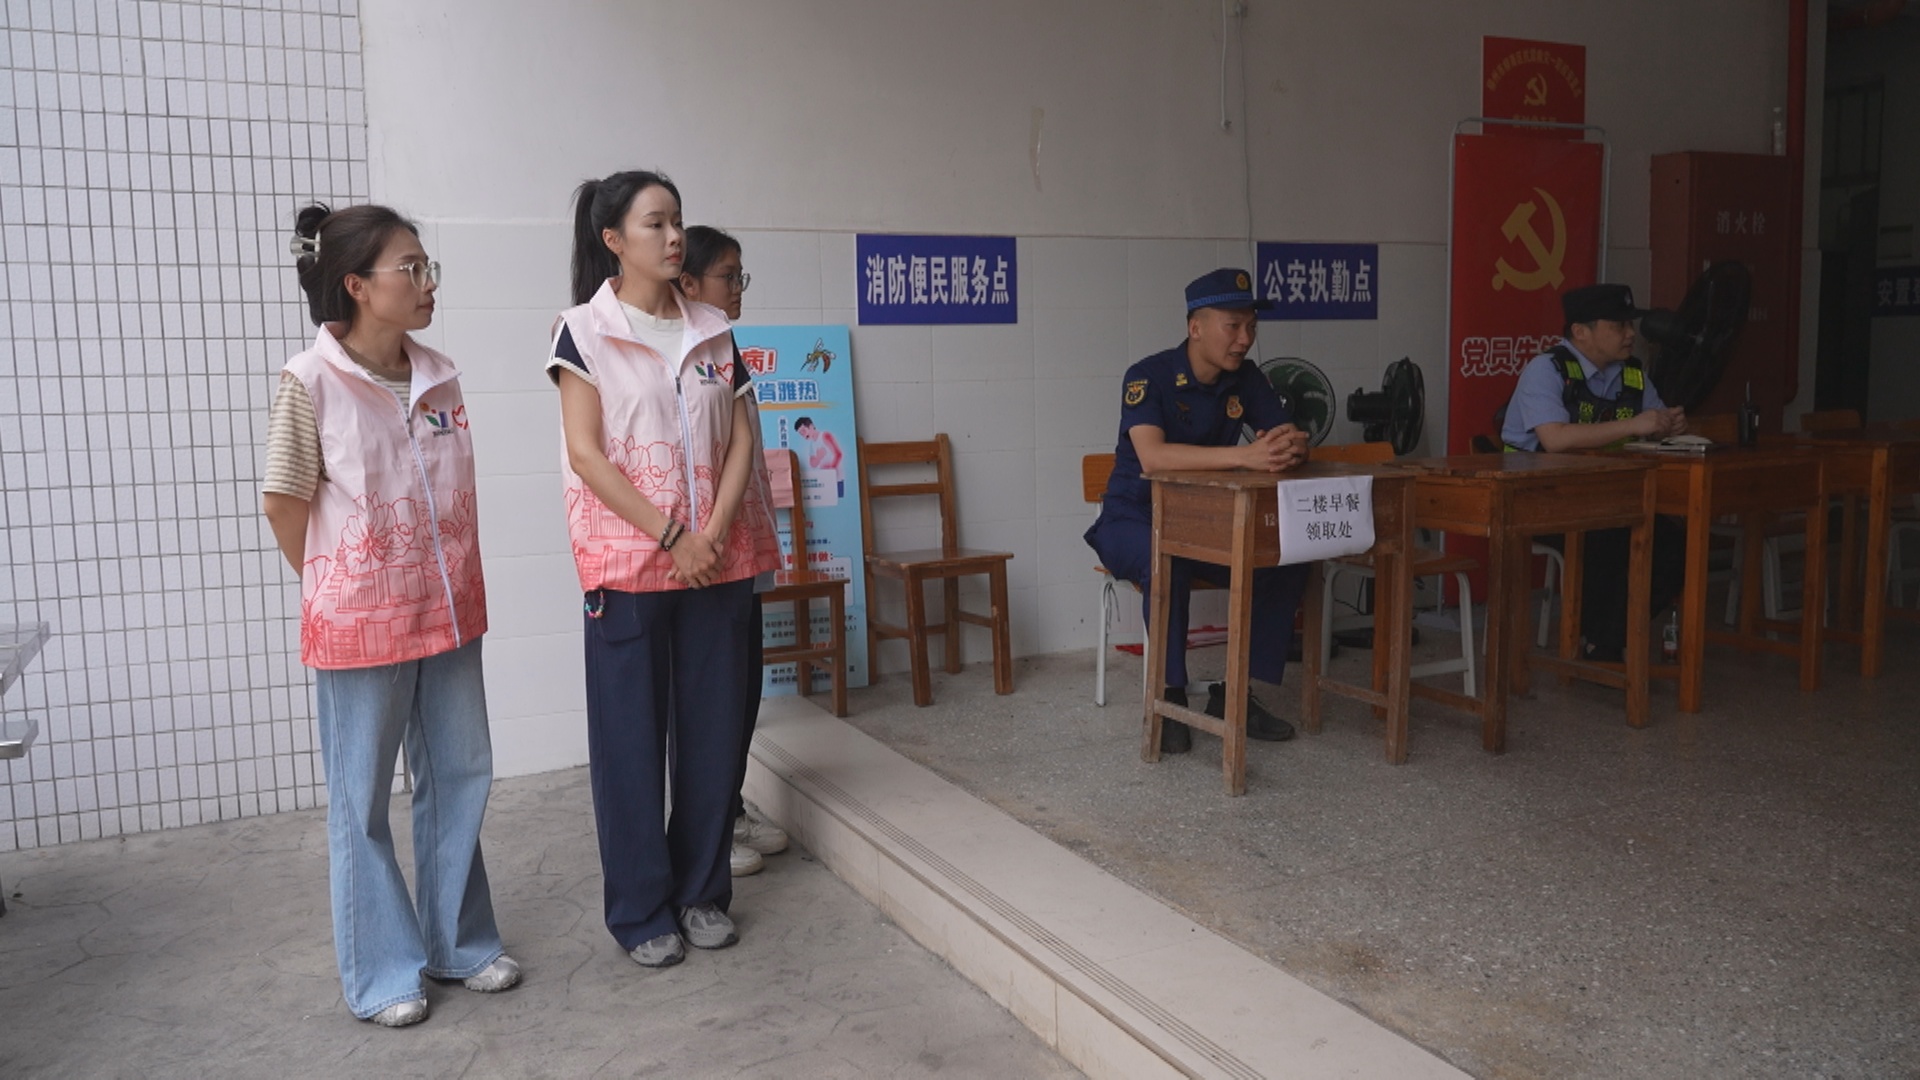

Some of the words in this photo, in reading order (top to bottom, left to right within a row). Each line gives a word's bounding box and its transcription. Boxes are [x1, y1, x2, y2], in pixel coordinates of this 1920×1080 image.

[1716, 210, 1766, 235] 消火栓
[865, 254, 1010, 305] 消防便民服务点
[1263, 259, 1372, 303] 公安执勤点
[757, 381, 818, 402] 肯雅热
[1297, 492, 1360, 514] 二楼早餐
[1306, 520, 1353, 540] 领取处
